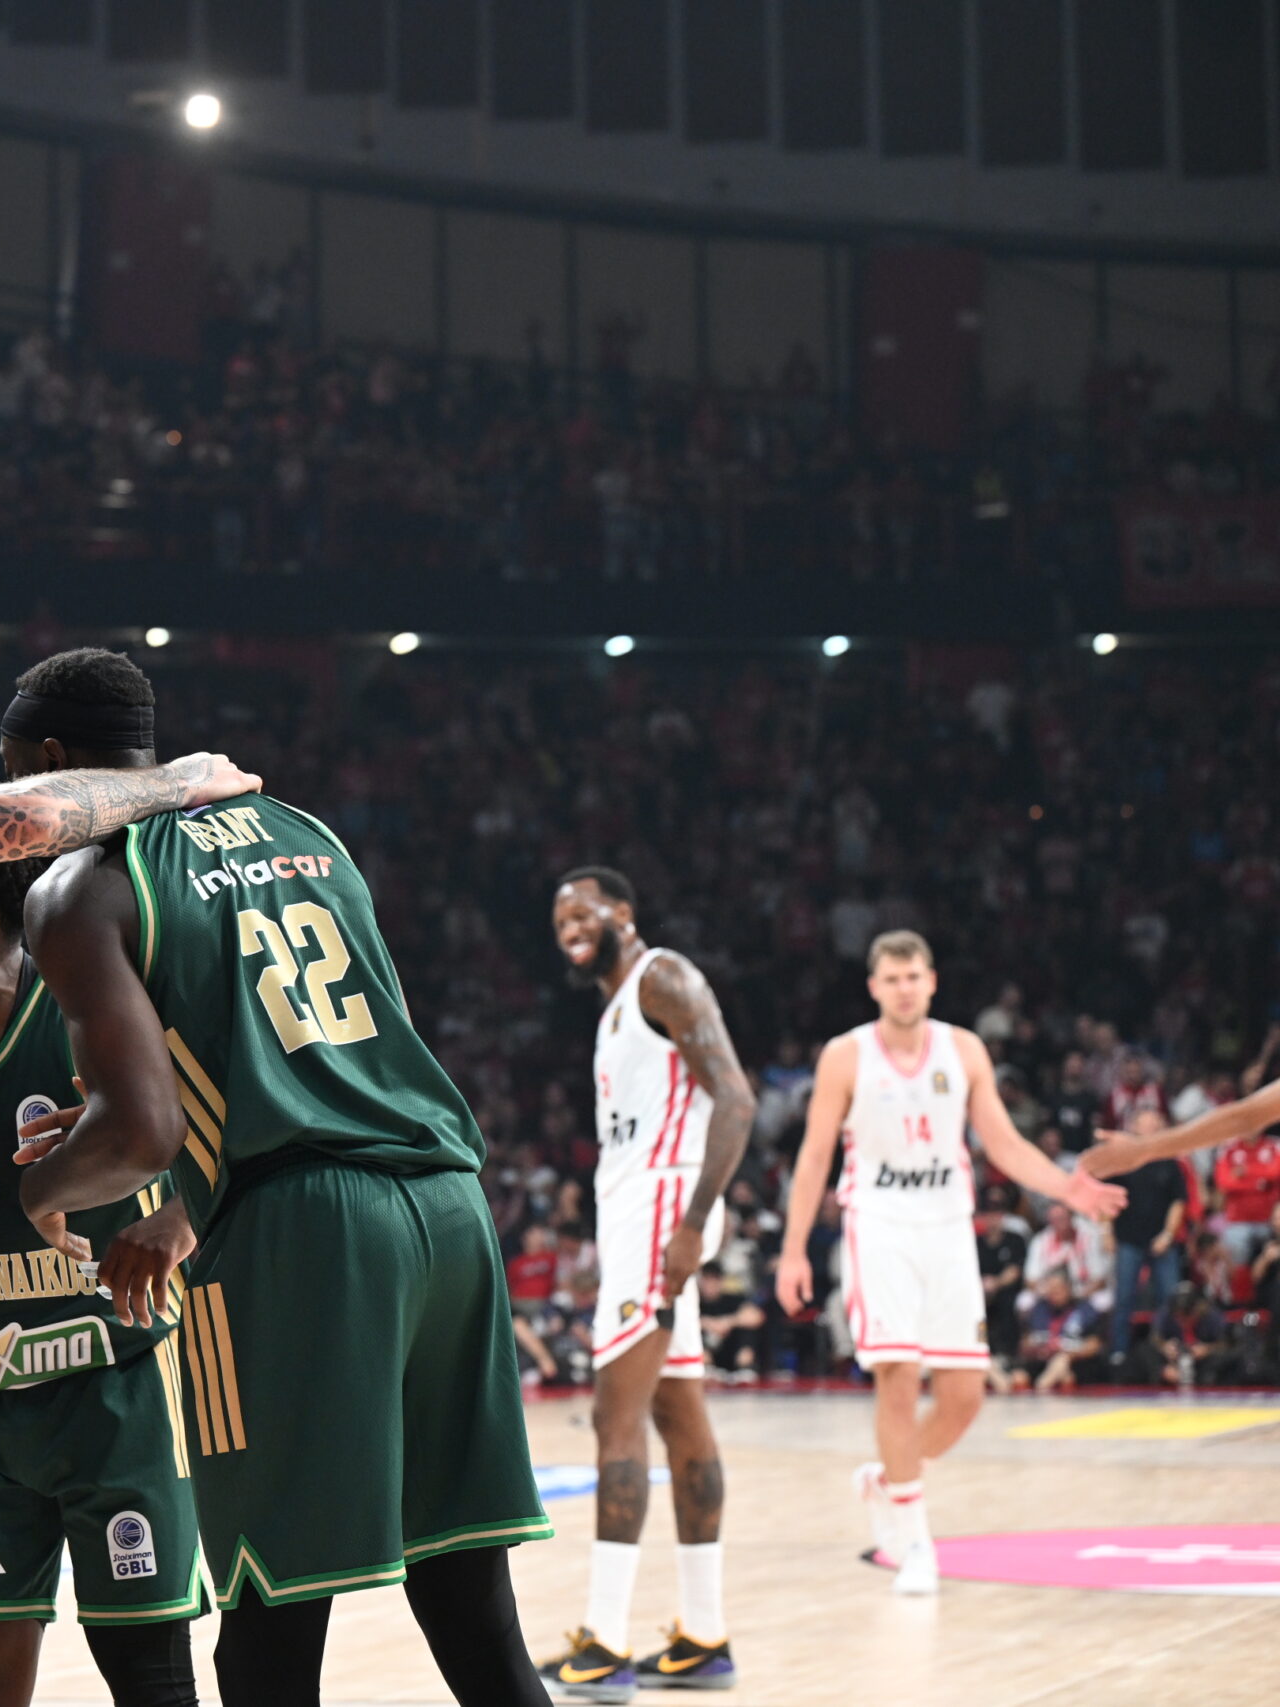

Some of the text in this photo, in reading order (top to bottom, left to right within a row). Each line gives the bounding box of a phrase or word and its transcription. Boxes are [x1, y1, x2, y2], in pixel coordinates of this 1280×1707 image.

[237, 901, 378, 1054] 22
[902, 1114, 932, 1144] 14
[113, 1551, 152, 1563] Stoiximan
[116, 1559, 153, 1576] GBL
